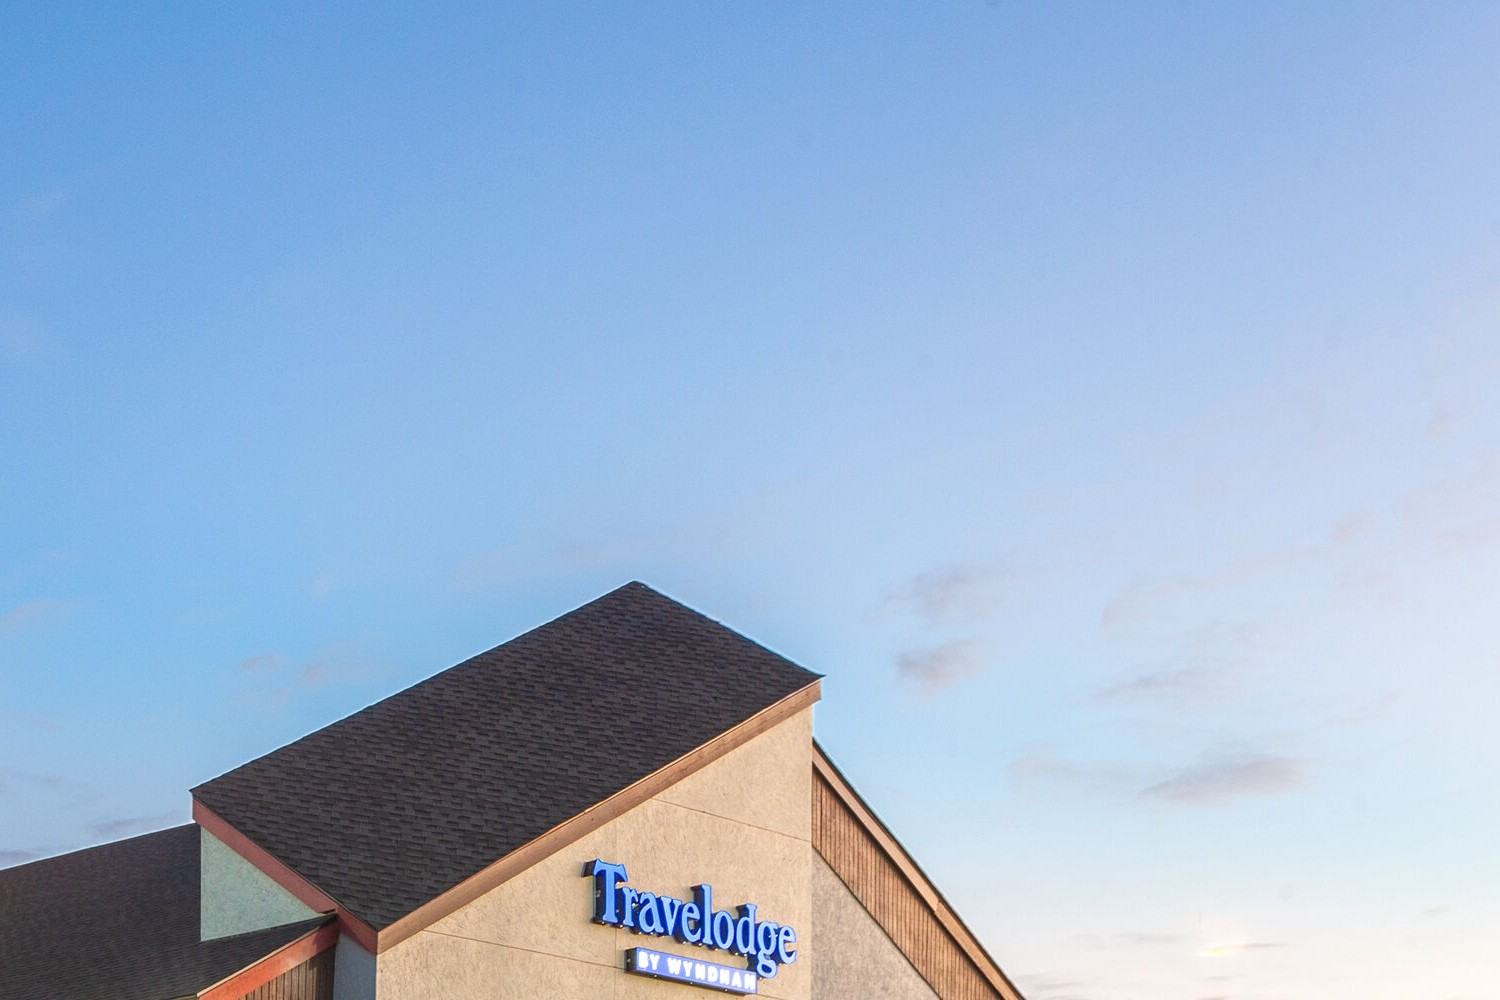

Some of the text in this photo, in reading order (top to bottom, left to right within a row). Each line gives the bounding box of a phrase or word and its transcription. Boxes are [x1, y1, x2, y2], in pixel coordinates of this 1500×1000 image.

[592, 858, 797, 979] Travelodge
[638, 951, 756, 991] BY WYNDHAM
